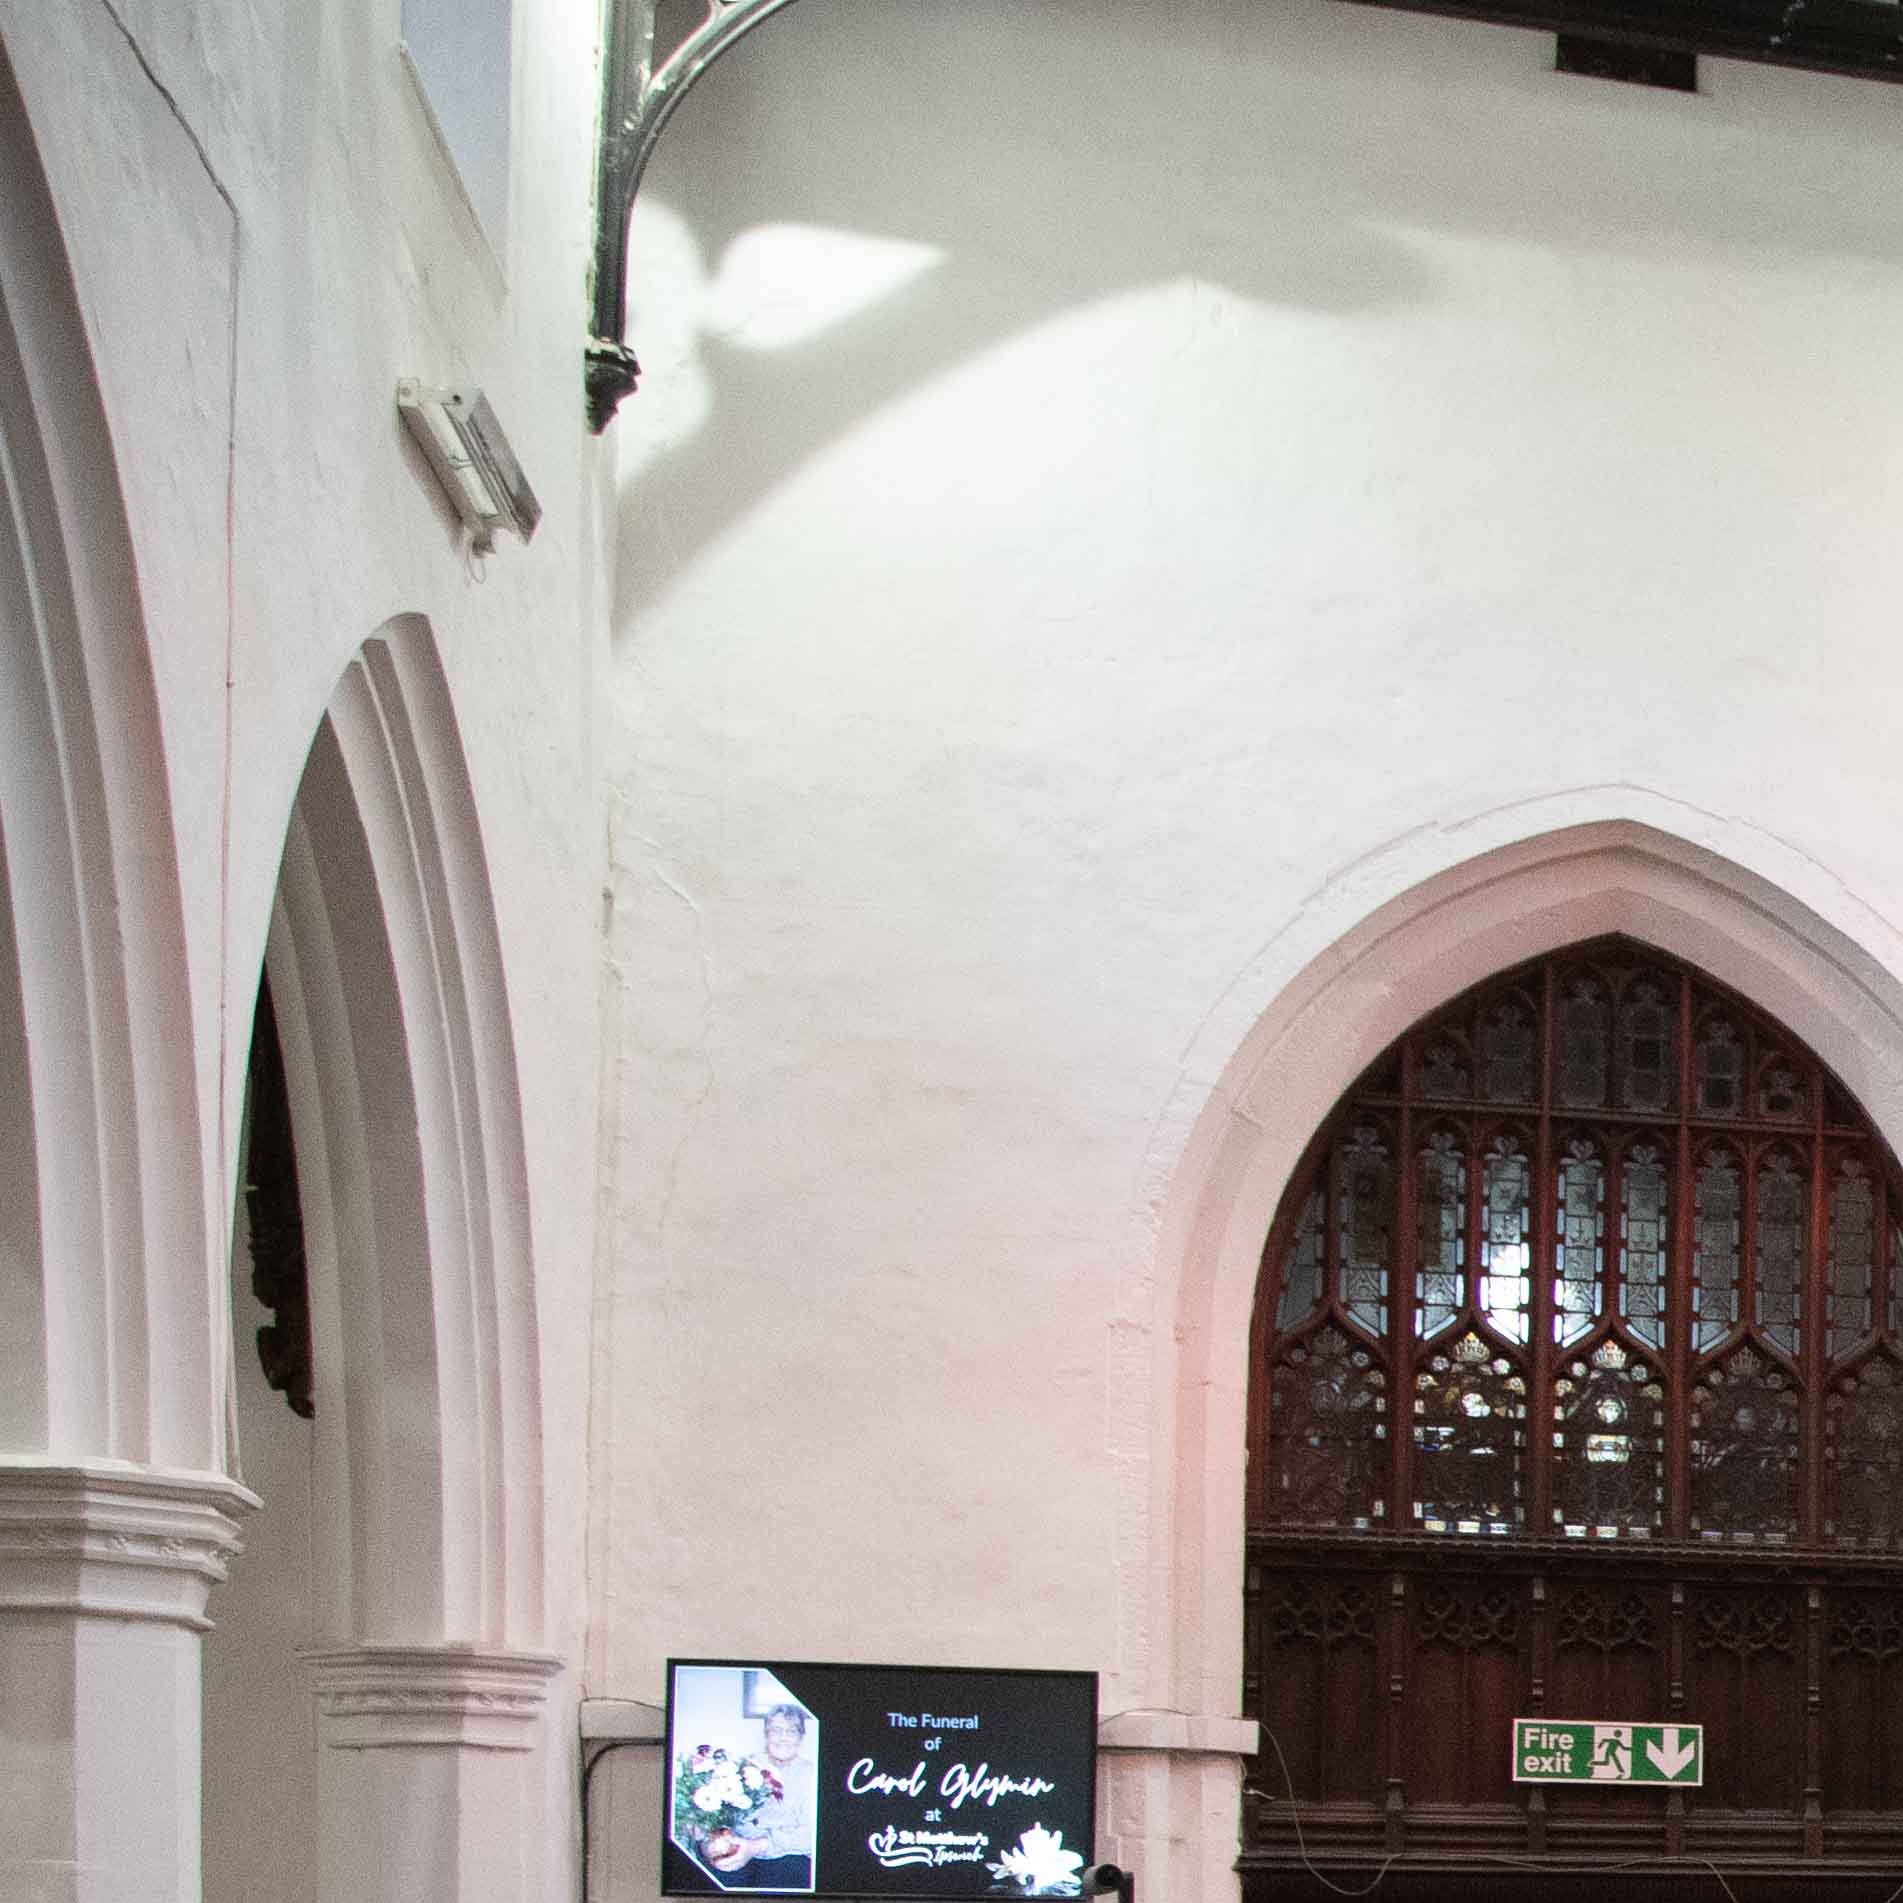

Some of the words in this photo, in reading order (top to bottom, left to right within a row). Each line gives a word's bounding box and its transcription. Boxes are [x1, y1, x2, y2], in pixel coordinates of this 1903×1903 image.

[888, 1712, 917, 1728] The
[921, 1714, 979, 1729] Funeral
[924, 1737, 942, 1750] of
[1524, 1727, 1574, 1750] Fire
[1524, 1752, 1572, 1773] exit
[847, 1758, 926, 1797] Carol
[924, 1808, 941, 1822] at
